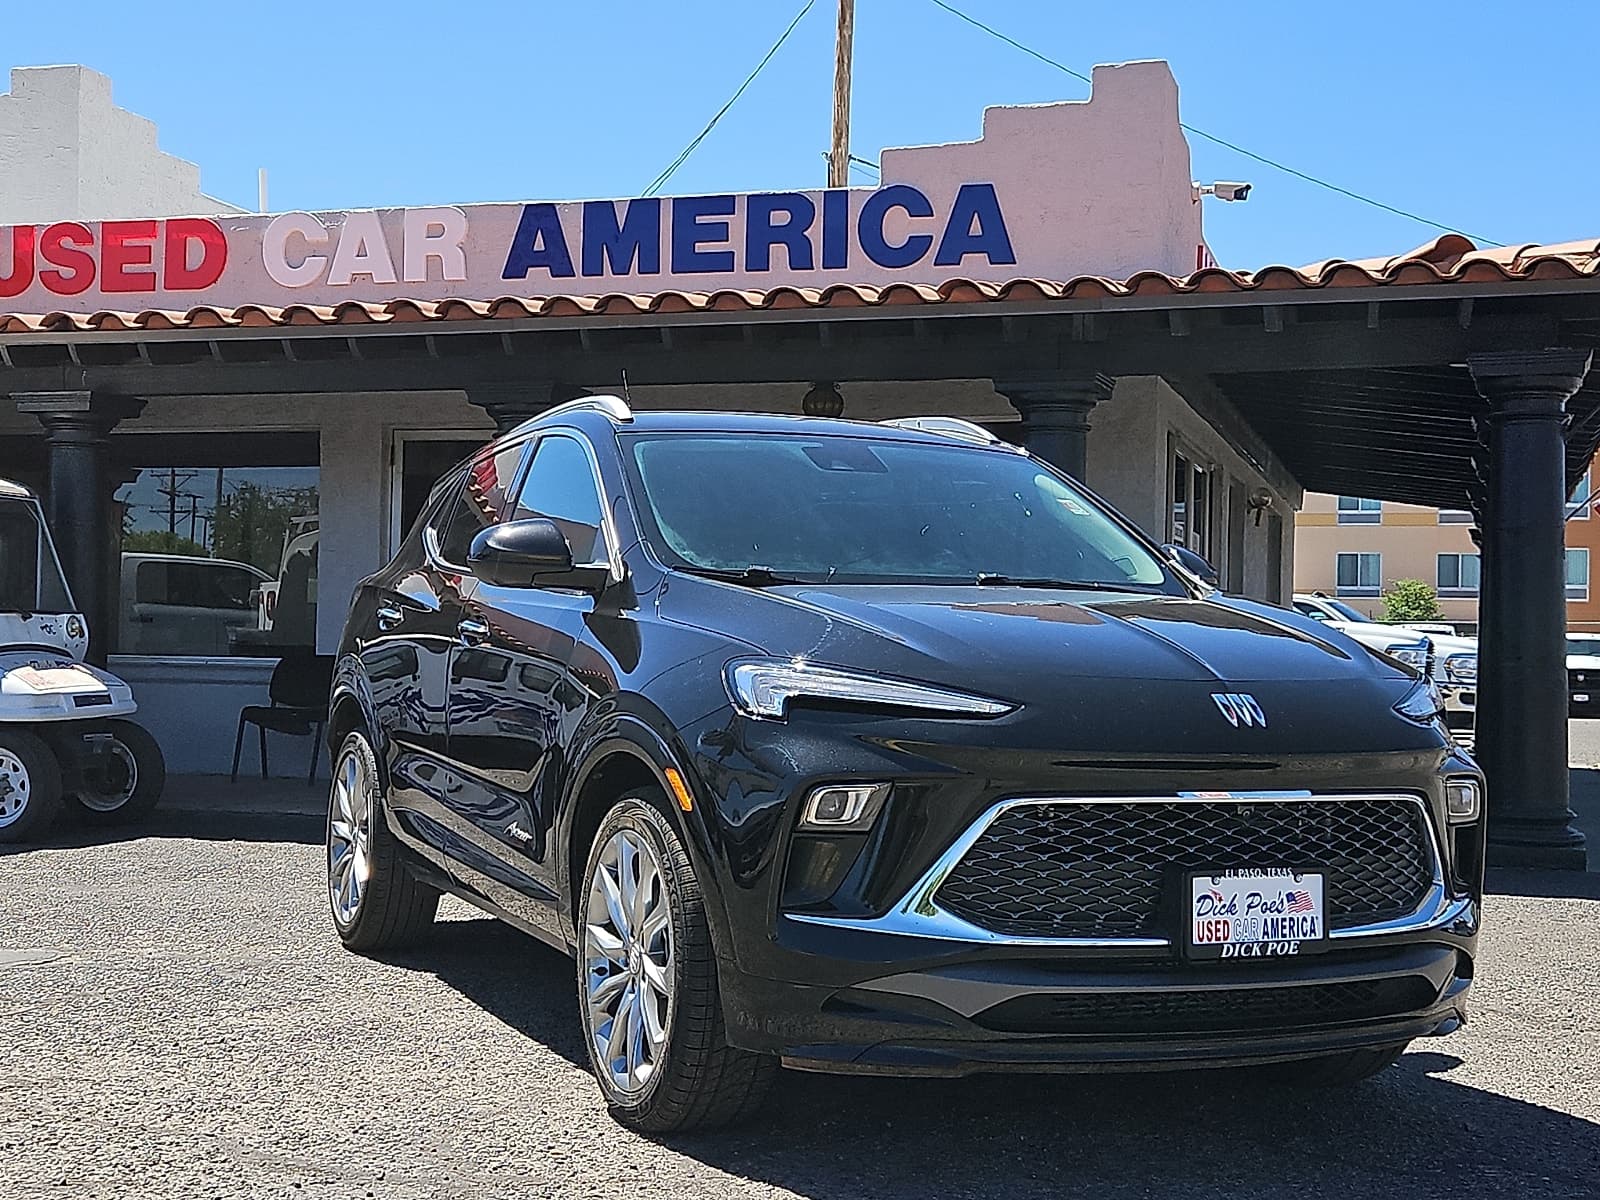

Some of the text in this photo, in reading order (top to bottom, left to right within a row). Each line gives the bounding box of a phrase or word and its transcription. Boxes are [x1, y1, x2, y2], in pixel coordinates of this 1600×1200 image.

[0, 183, 1017, 298] USED CAR AMERICA
[1267, 867, 1293, 878] TEXAS
[1196, 891, 1286, 917] Dick Poe's
[1197, 915, 1317, 942] USED CAR AMERICA
[1220, 941, 1300, 958] DICK POE
